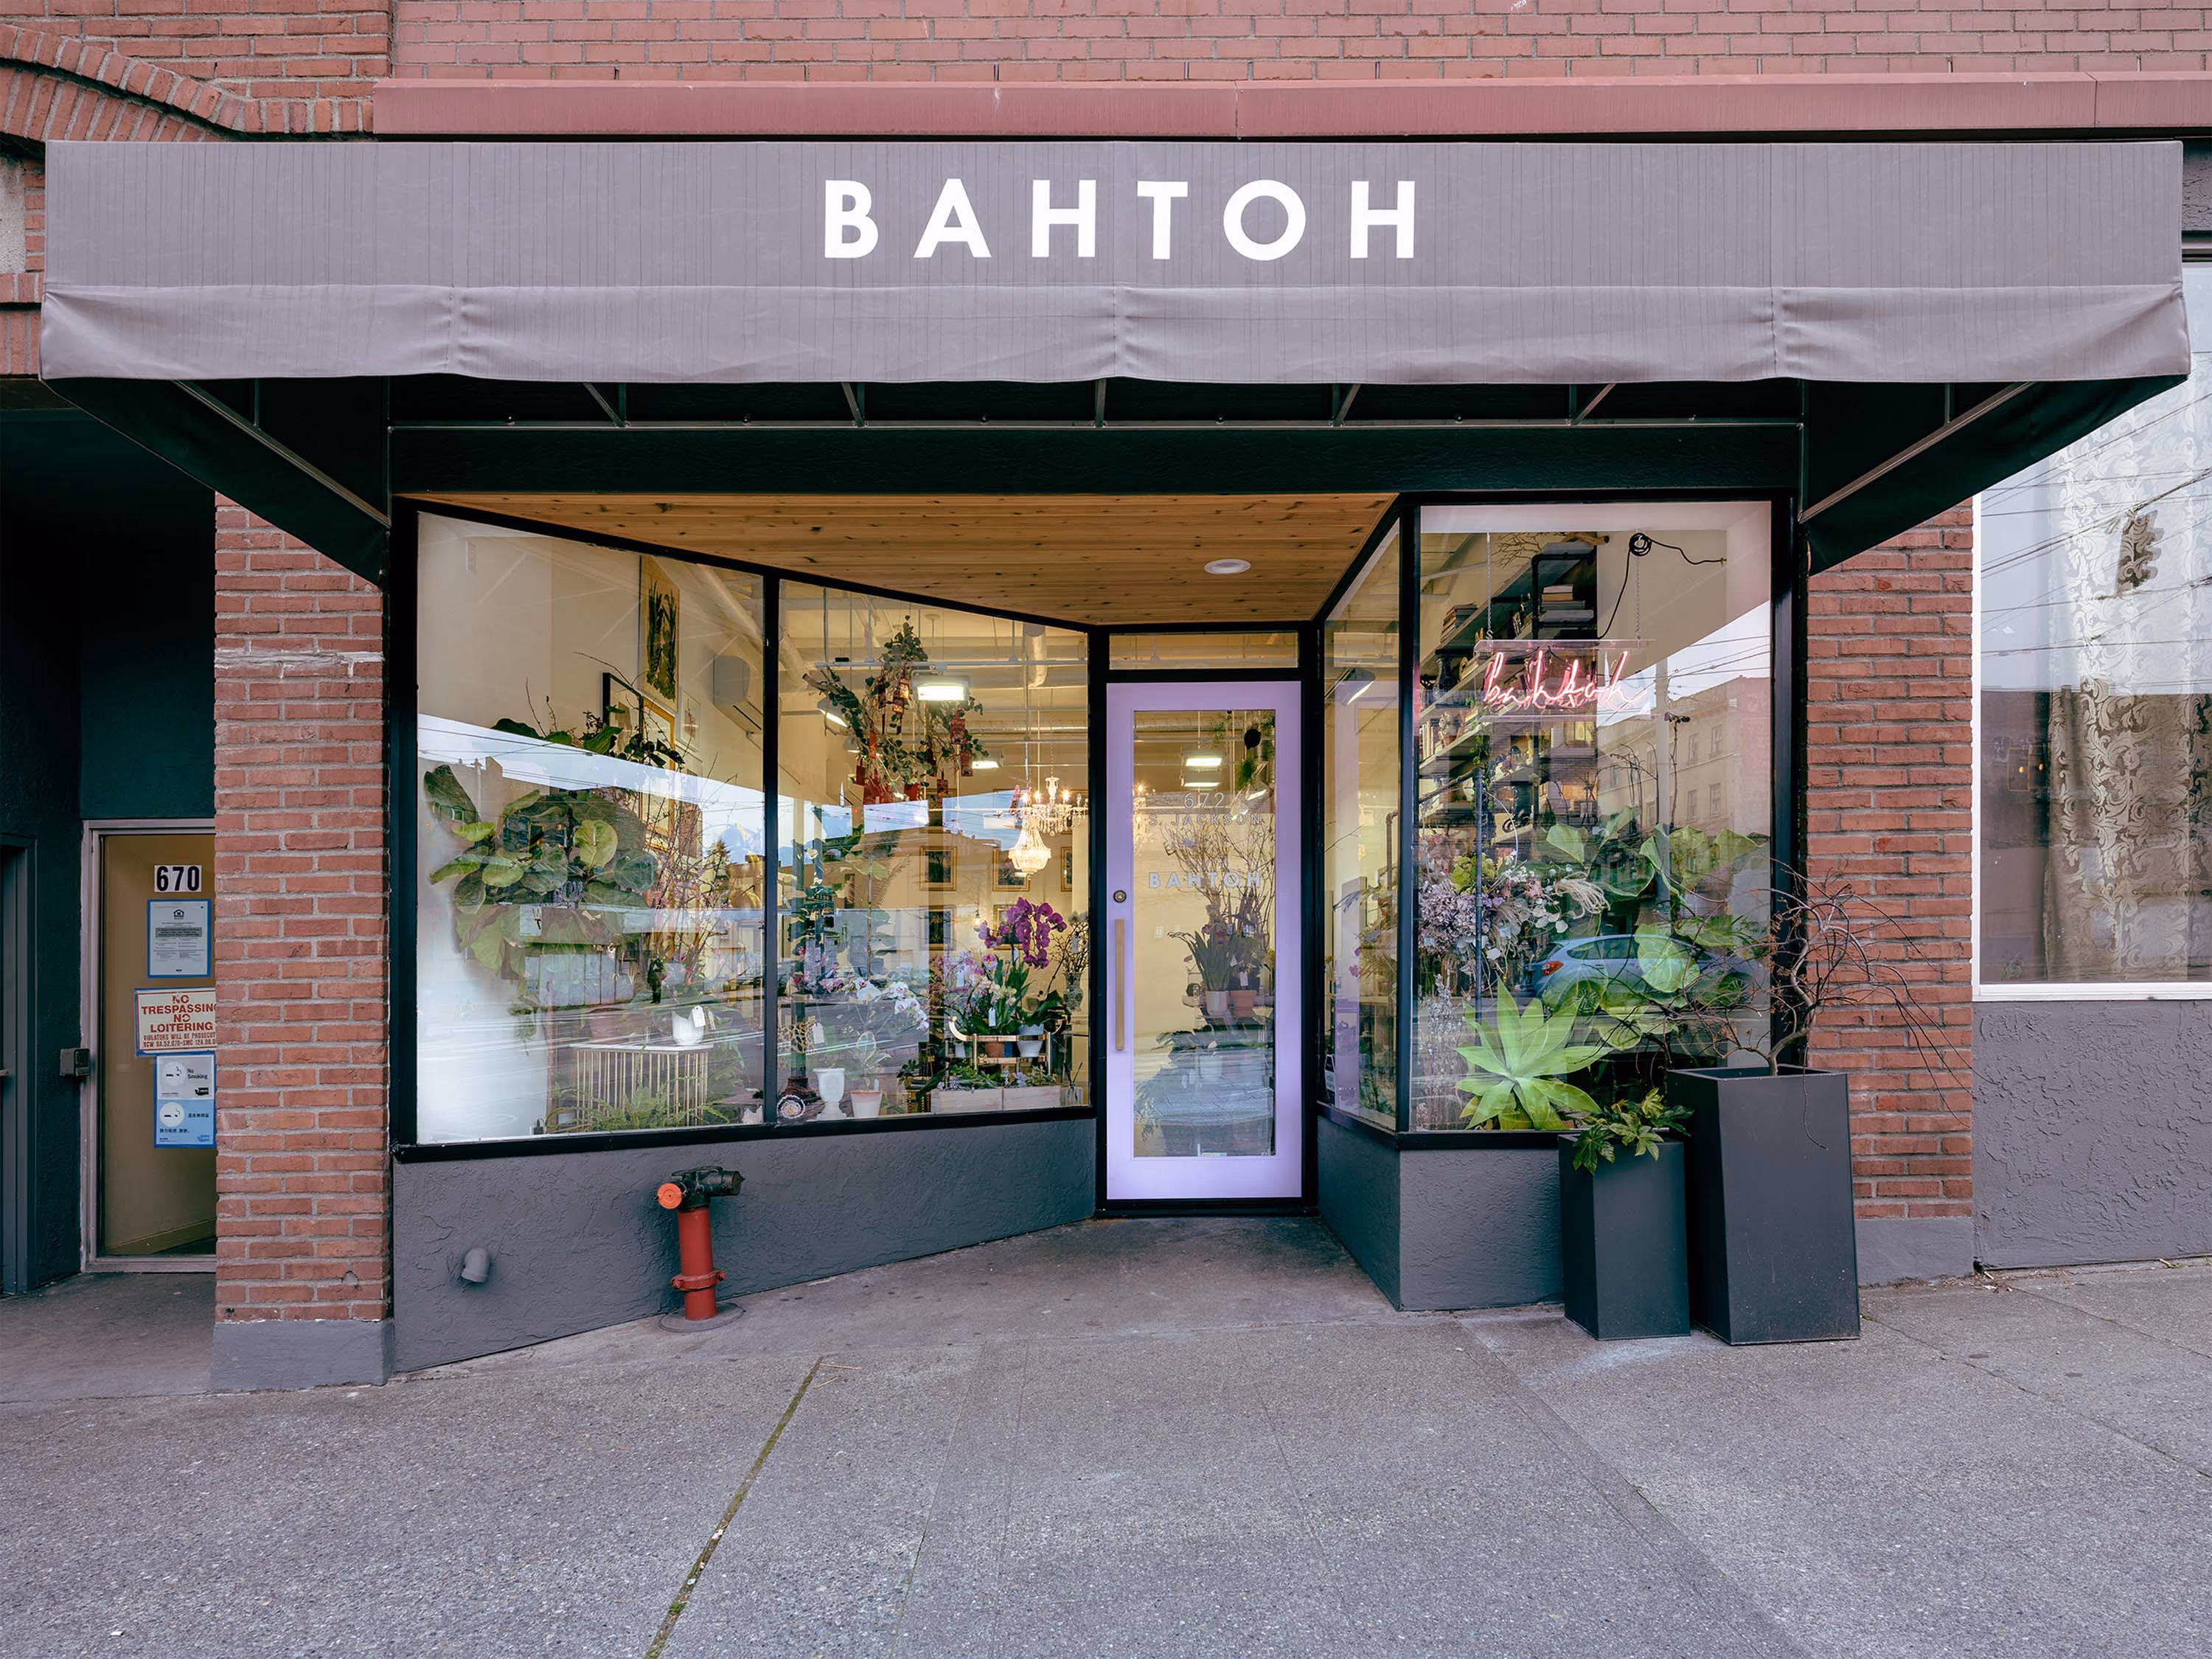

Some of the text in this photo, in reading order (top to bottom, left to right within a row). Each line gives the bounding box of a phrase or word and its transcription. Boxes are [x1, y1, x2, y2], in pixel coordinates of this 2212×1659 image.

[824, 178, 1415, 261] BAHTOH
[1184, 792, 1225, 808] 672
[1149, 813, 1262, 827] S. JACKSON
[157, 866, 199, 891] 670
[1150, 872, 1262, 889] BAHTOH
[172, 995, 189, 1004] NO
[173, 1013, 191, 1023] NO
[150, 1021, 213, 1033] LOITERING
